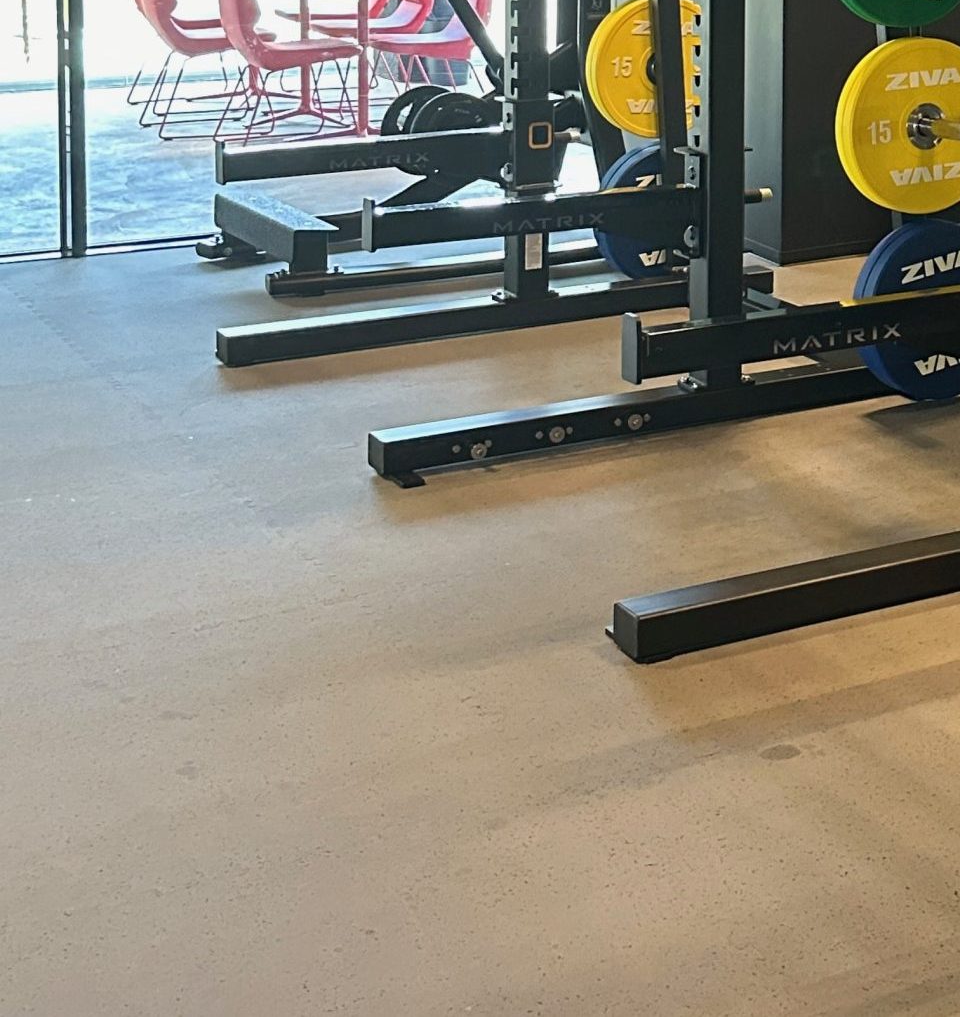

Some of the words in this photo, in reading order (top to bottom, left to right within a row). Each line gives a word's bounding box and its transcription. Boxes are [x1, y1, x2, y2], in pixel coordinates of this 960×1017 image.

[611, 56, 633, 78] 15
[867, 119, 892, 146] 15
[329, 151, 430, 170] MATRIX
[635, 174, 663, 188] ZI
[493, 212, 605, 234] MATRIX
[638, 249, 667, 267] VA
[773, 322, 901, 355] MATRIX
